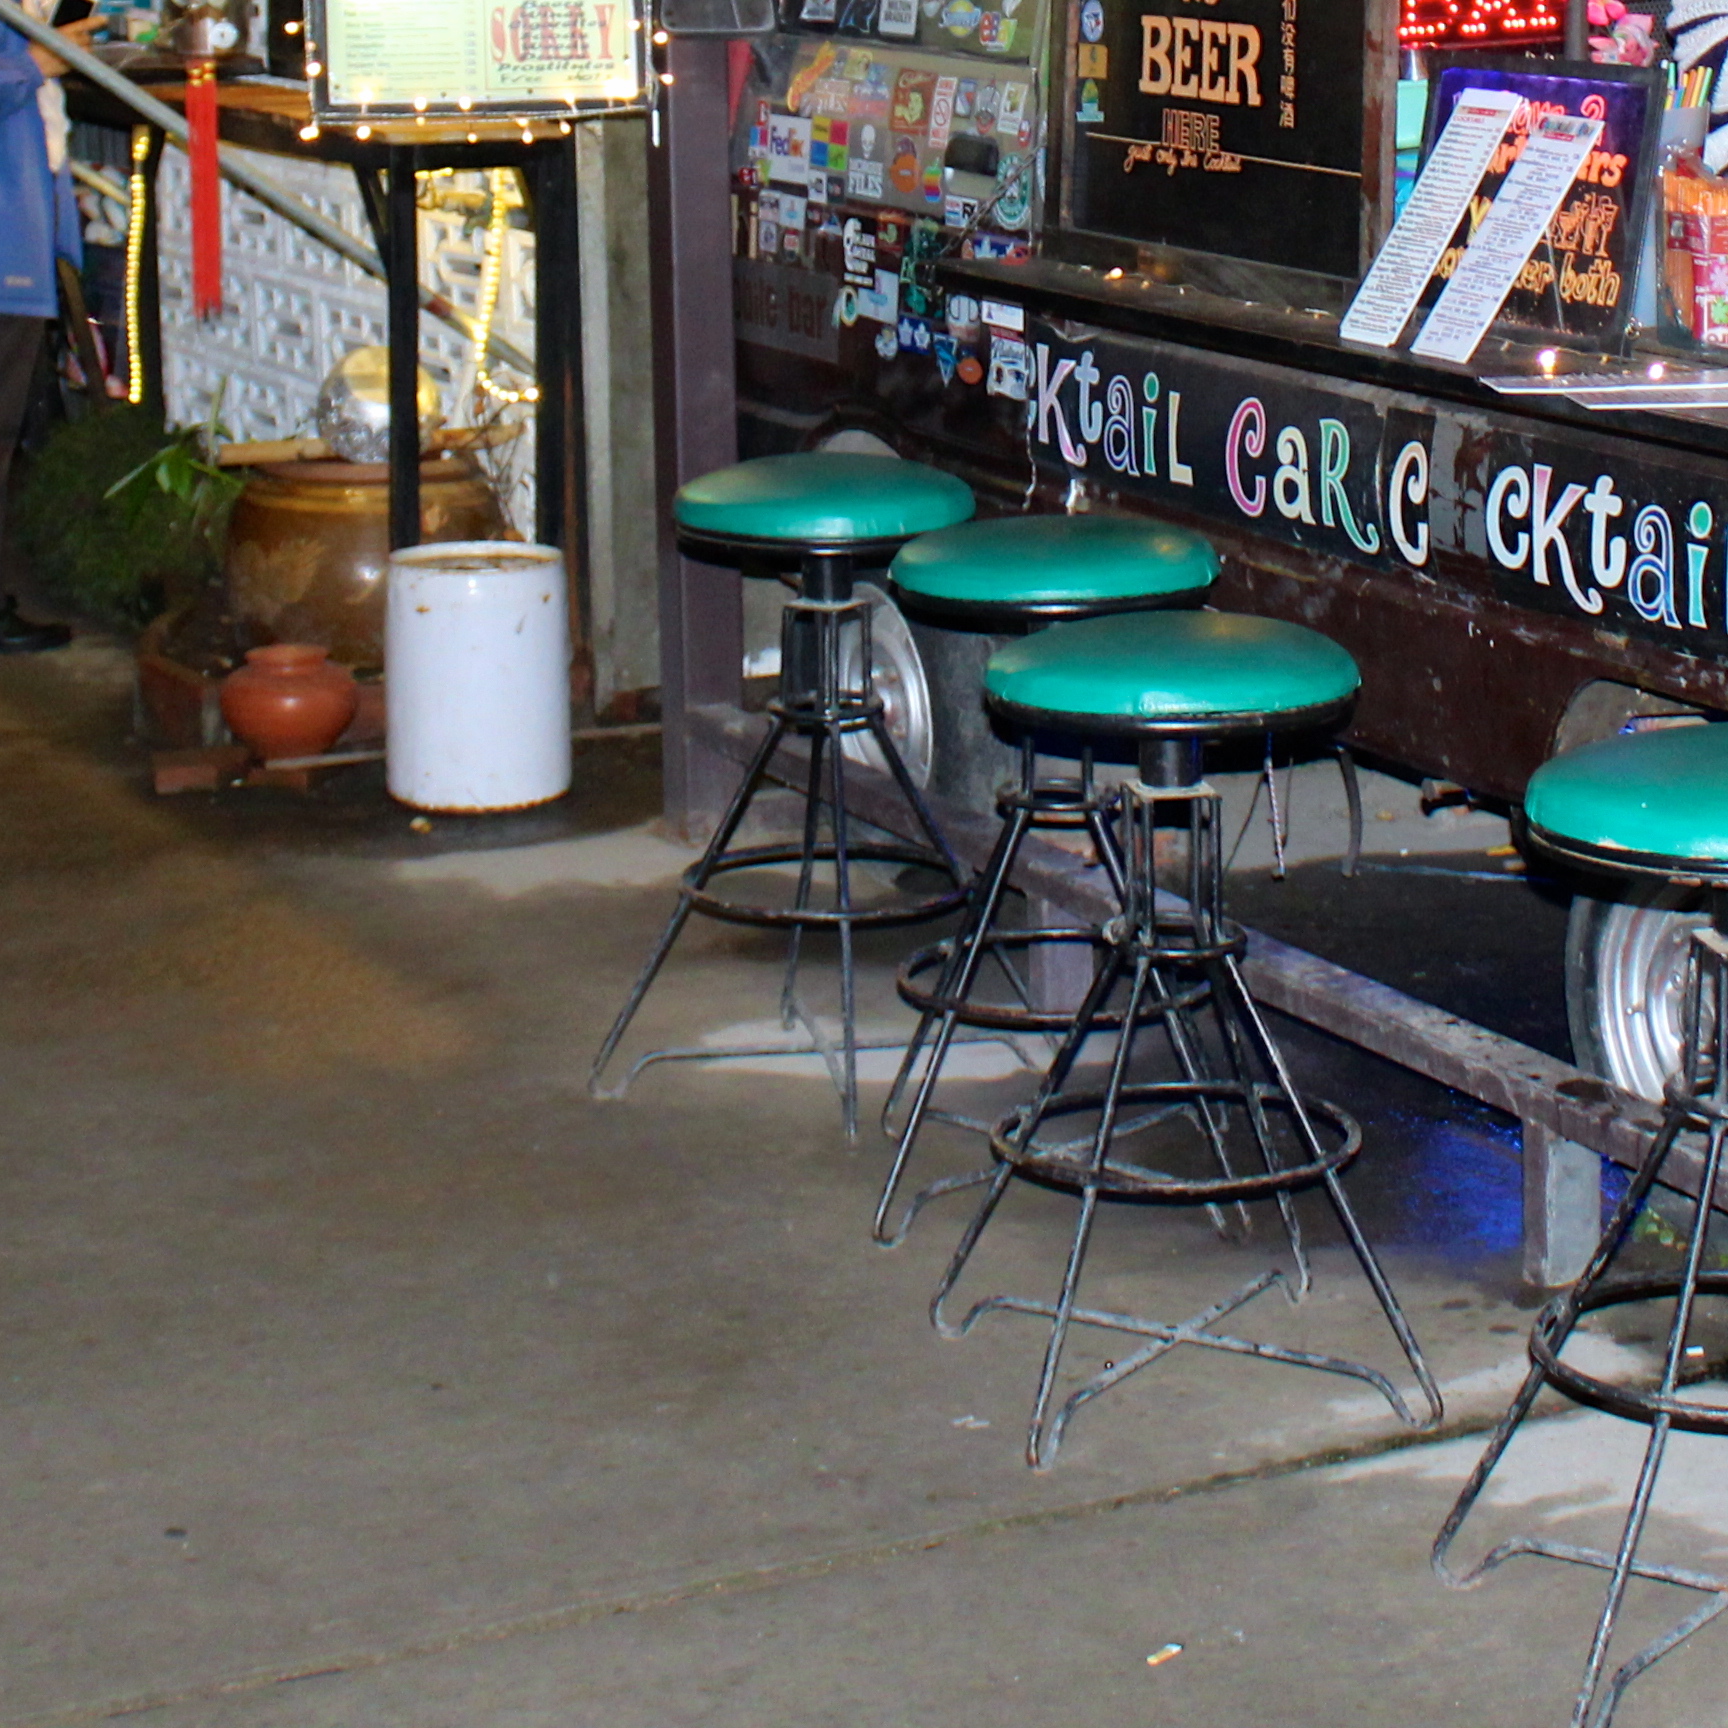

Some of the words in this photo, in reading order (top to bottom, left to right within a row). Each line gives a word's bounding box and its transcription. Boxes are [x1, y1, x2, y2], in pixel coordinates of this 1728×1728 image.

[490, 3, 616, 63] SORRY
[1139, 15, 1262, 107] BEER
[1162, 107, 1221, 154] HERE
[1559, 250, 1621, 307] both
